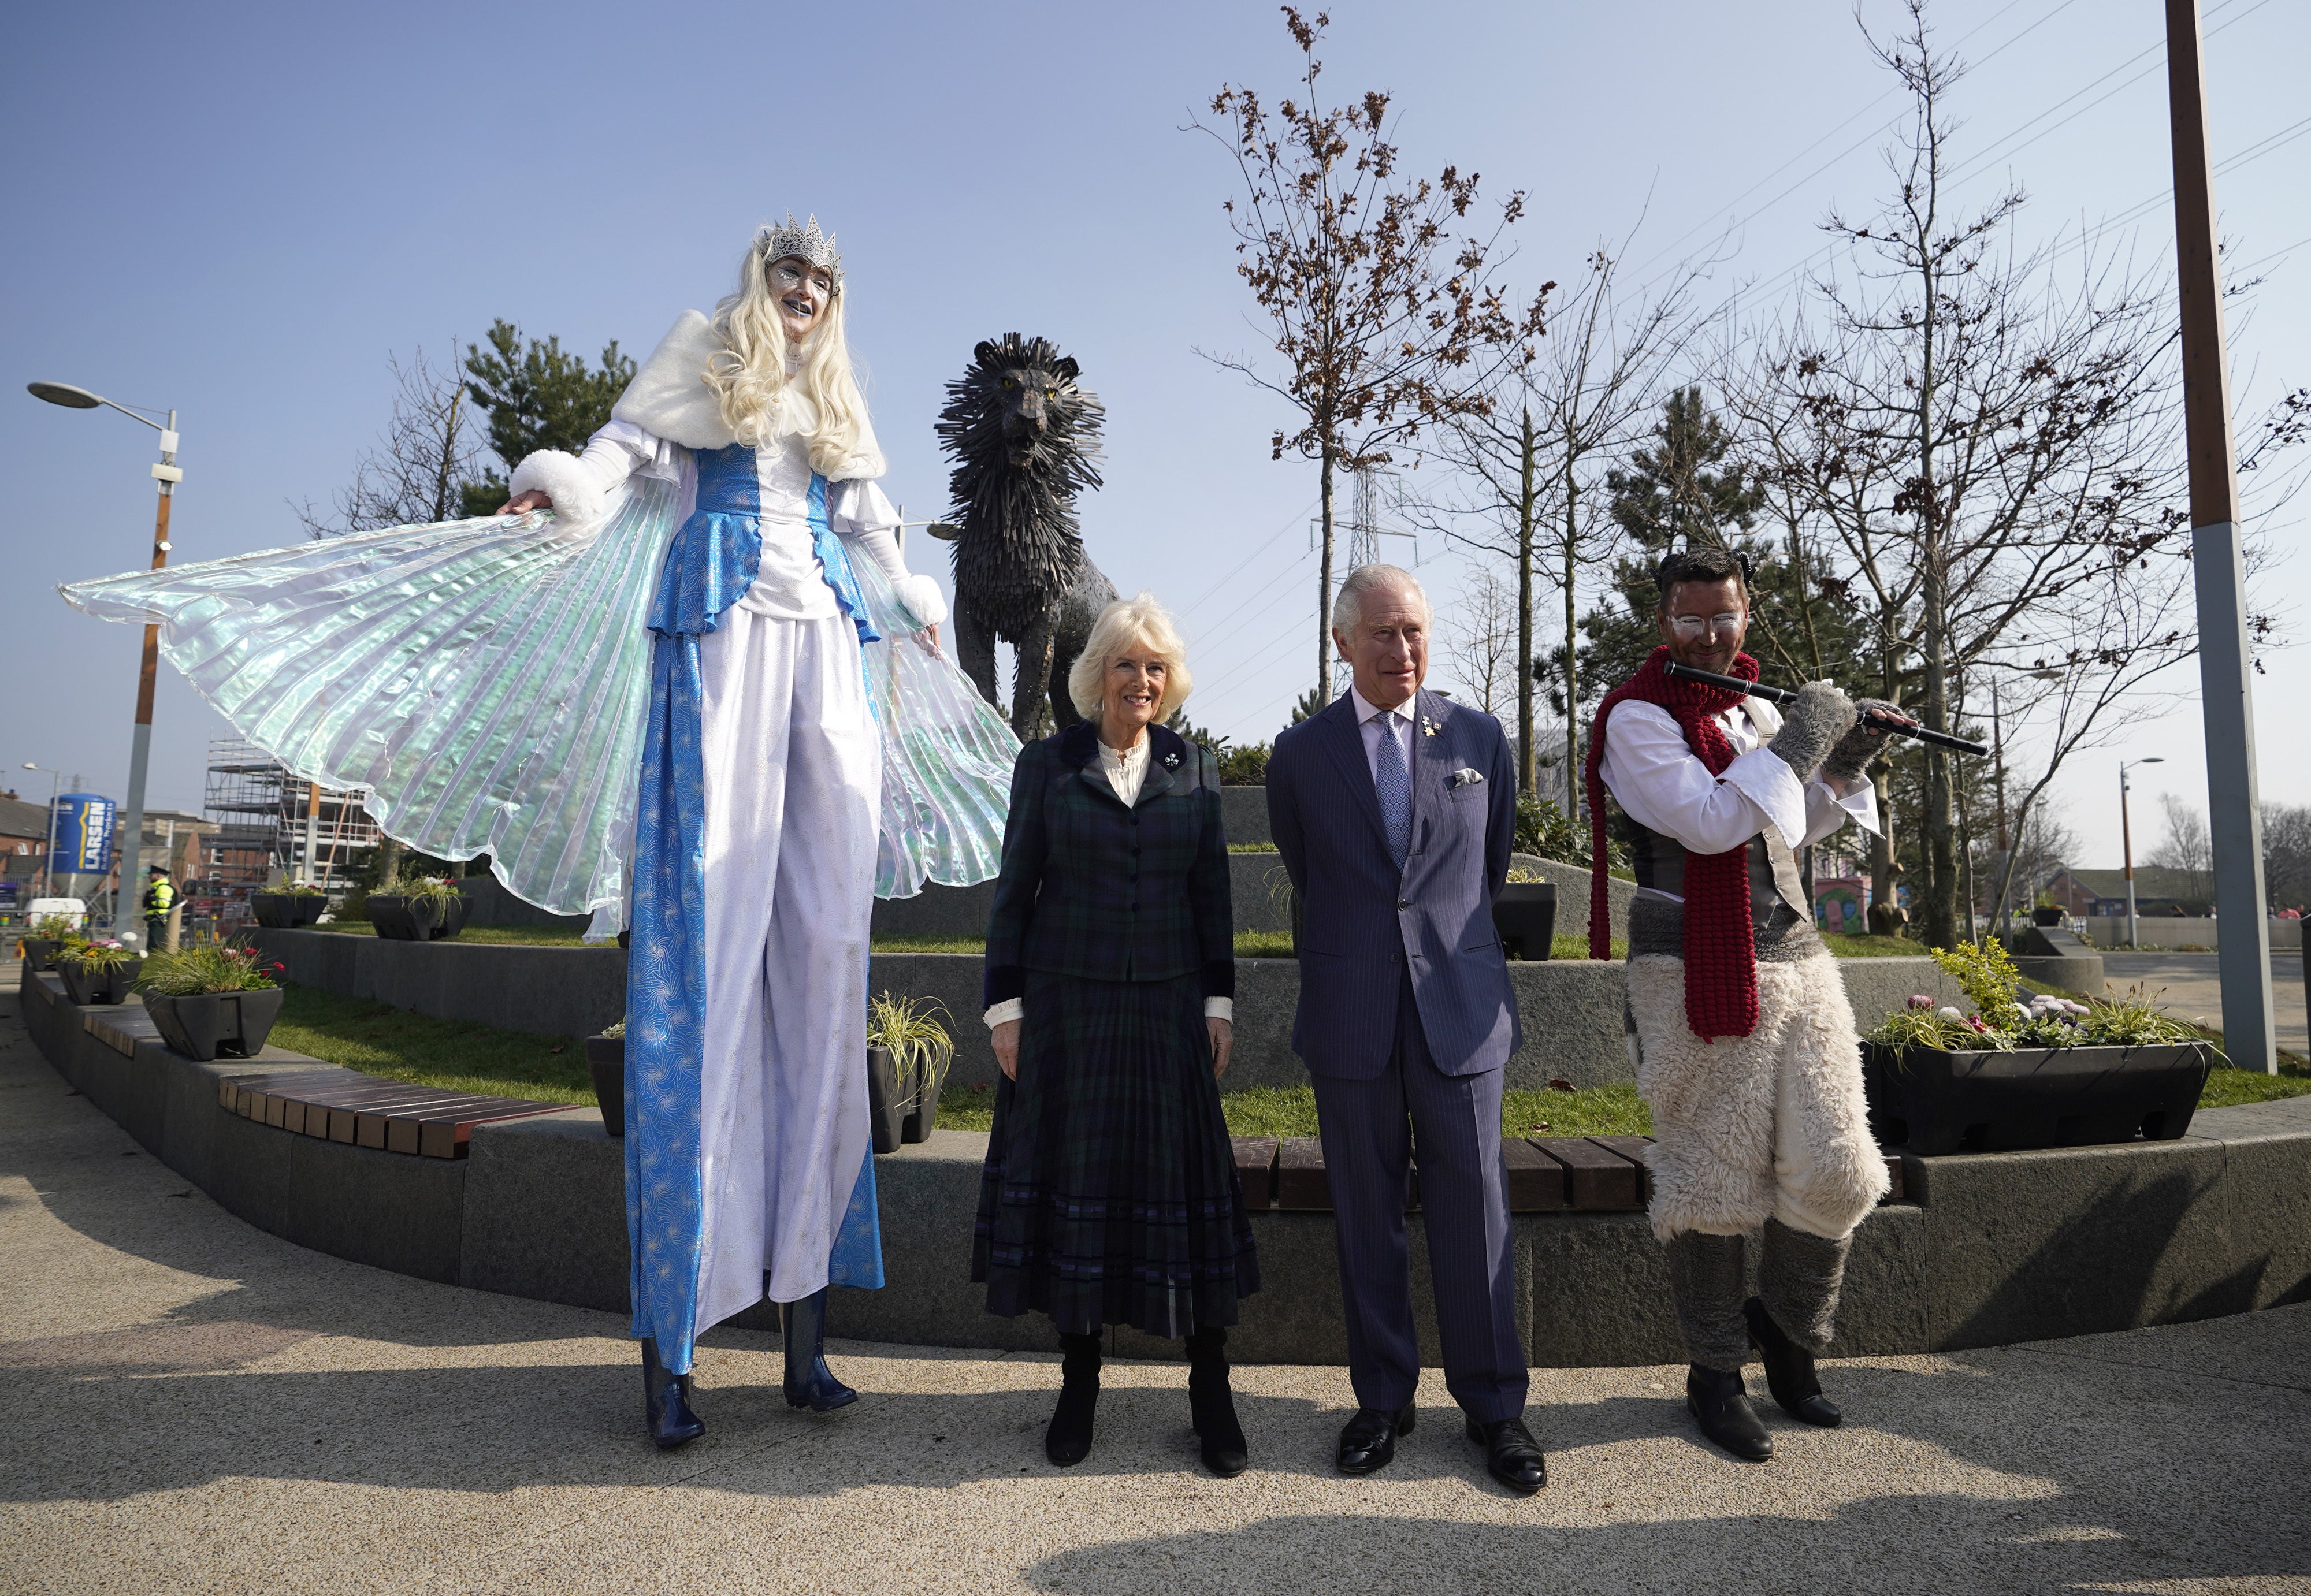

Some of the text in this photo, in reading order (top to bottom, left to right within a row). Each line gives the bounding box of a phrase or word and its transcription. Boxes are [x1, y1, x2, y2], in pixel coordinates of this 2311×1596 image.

[85, 802, 105, 869] LARSEN
[101, 803, 113, 870] Building Products
